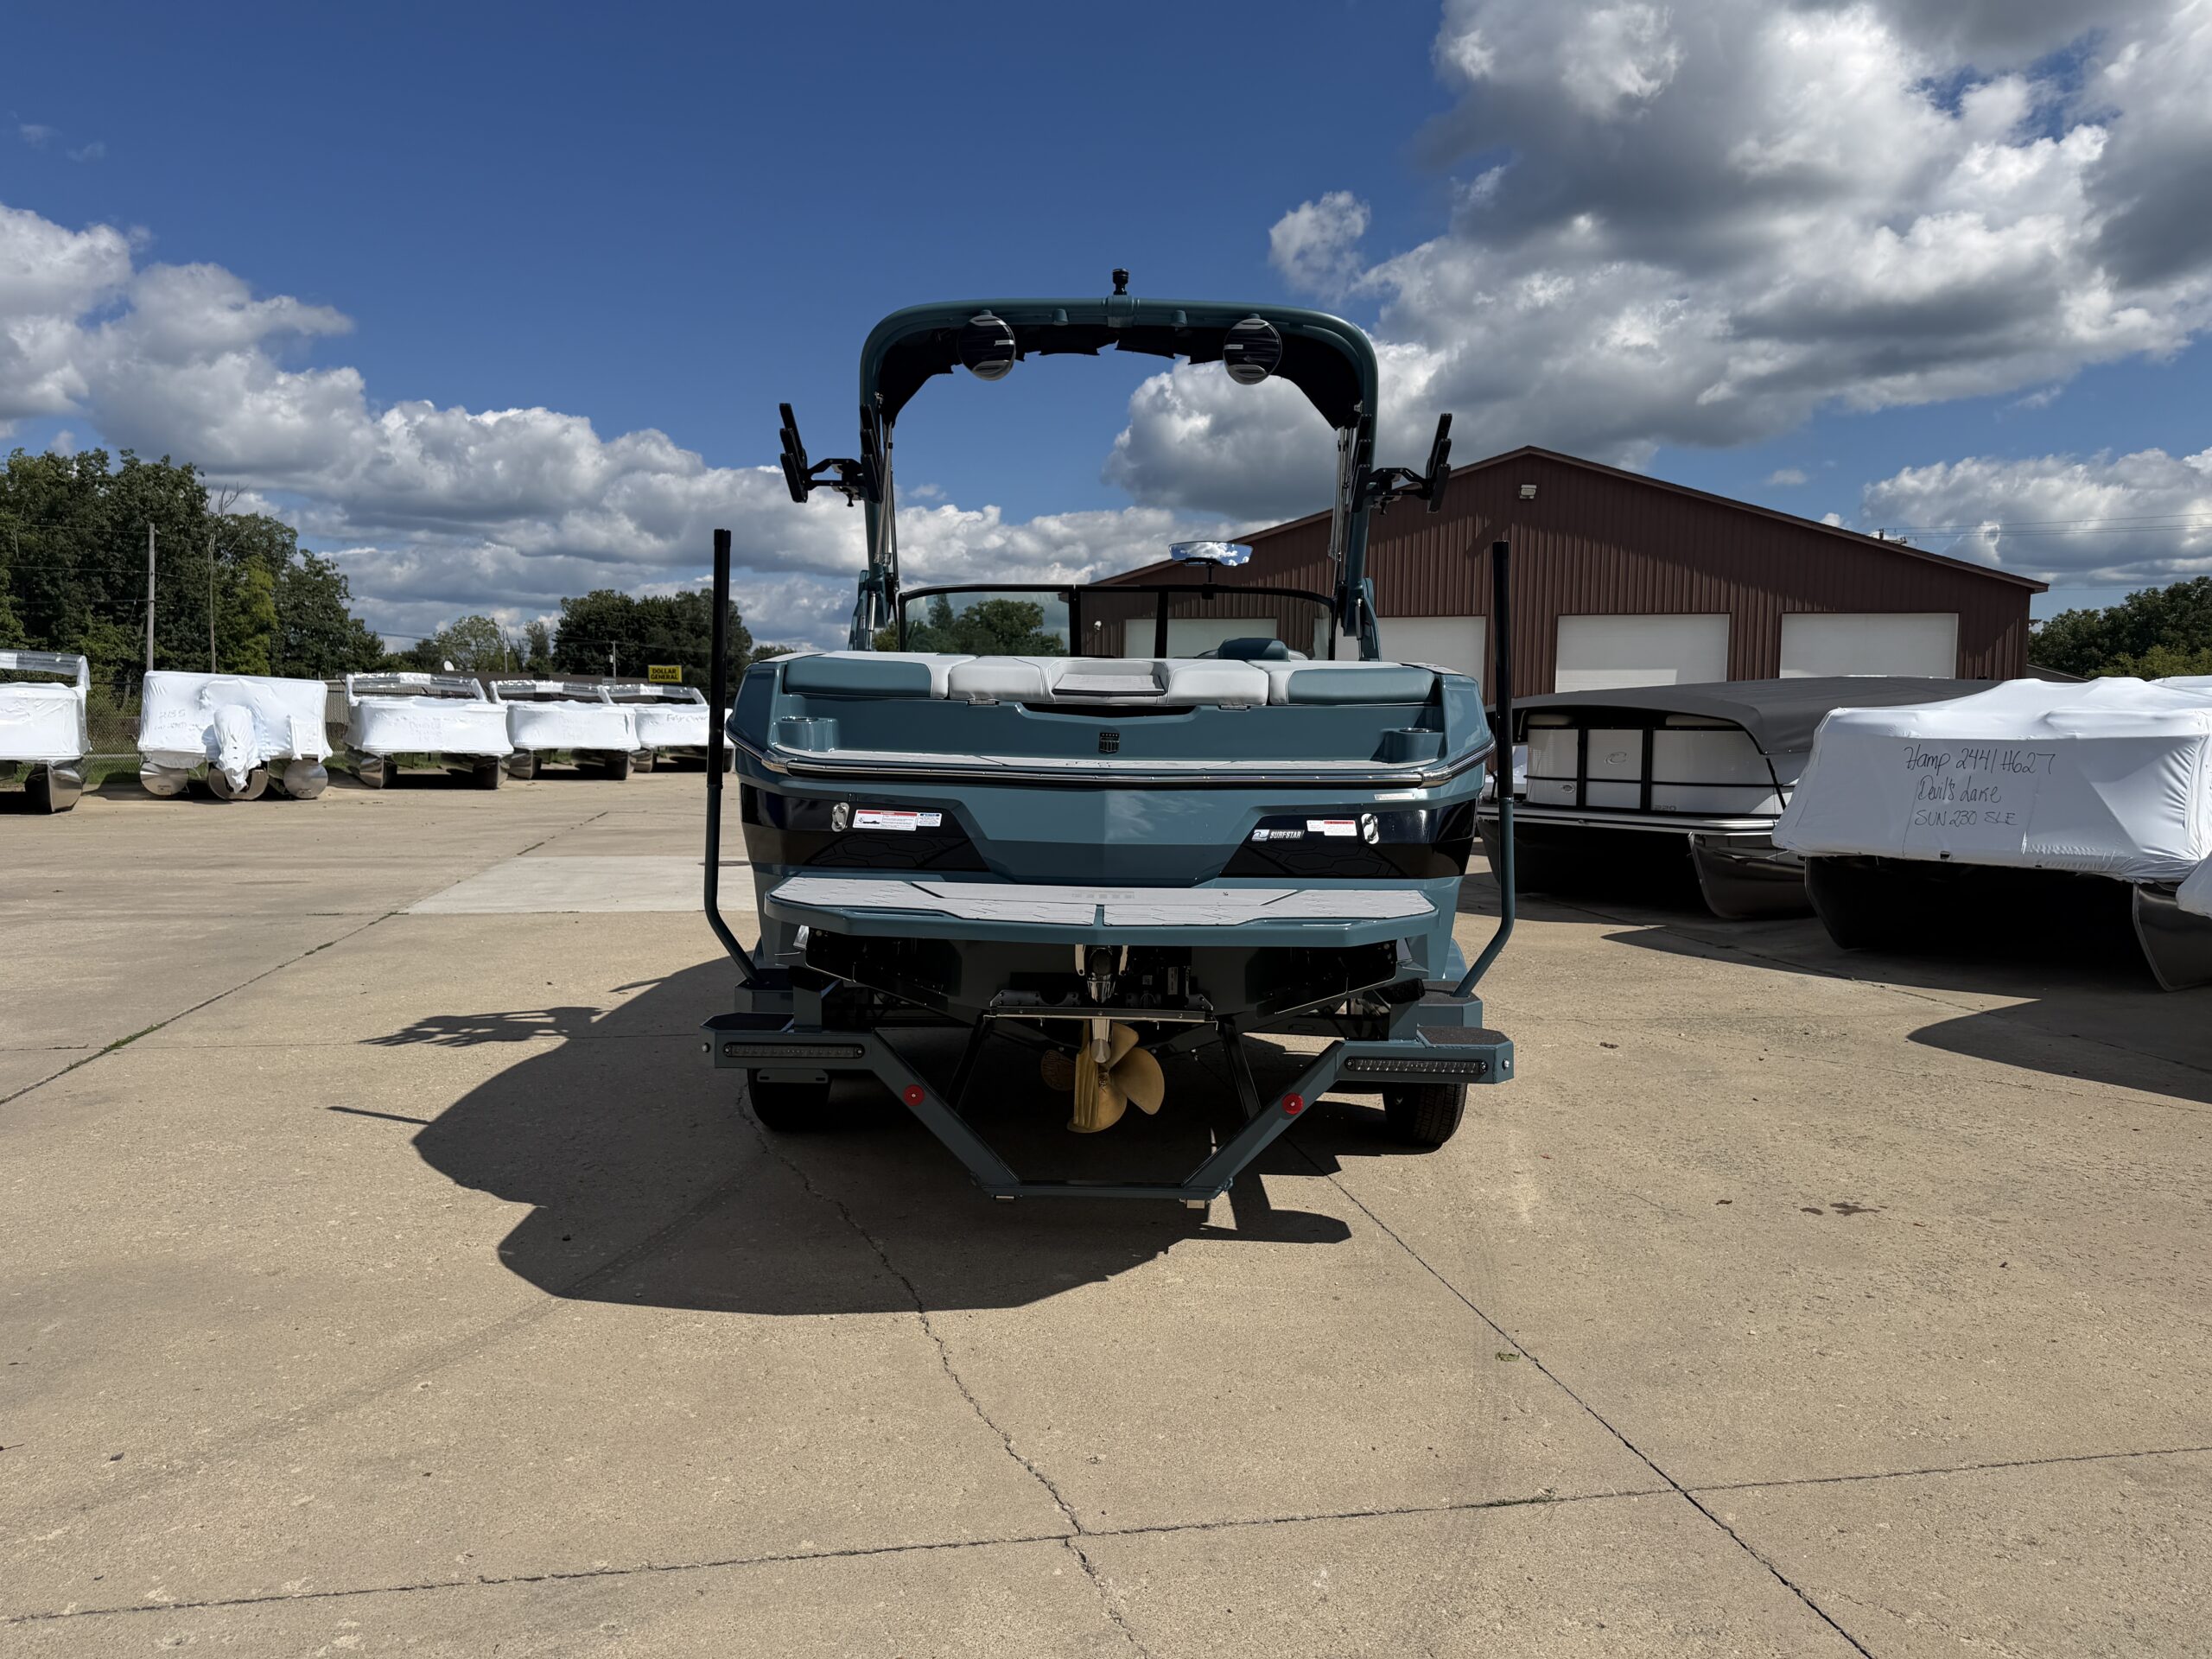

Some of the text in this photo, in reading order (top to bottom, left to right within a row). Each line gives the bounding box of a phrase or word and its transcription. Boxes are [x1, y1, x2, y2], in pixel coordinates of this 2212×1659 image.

[1904, 744, 1951, 776] Hamp
[1915, 809, 1947, 826] SUN
[1949, 810, 1978, 827] 230
[1269, 830, 1302, 839] SURFSTAR
